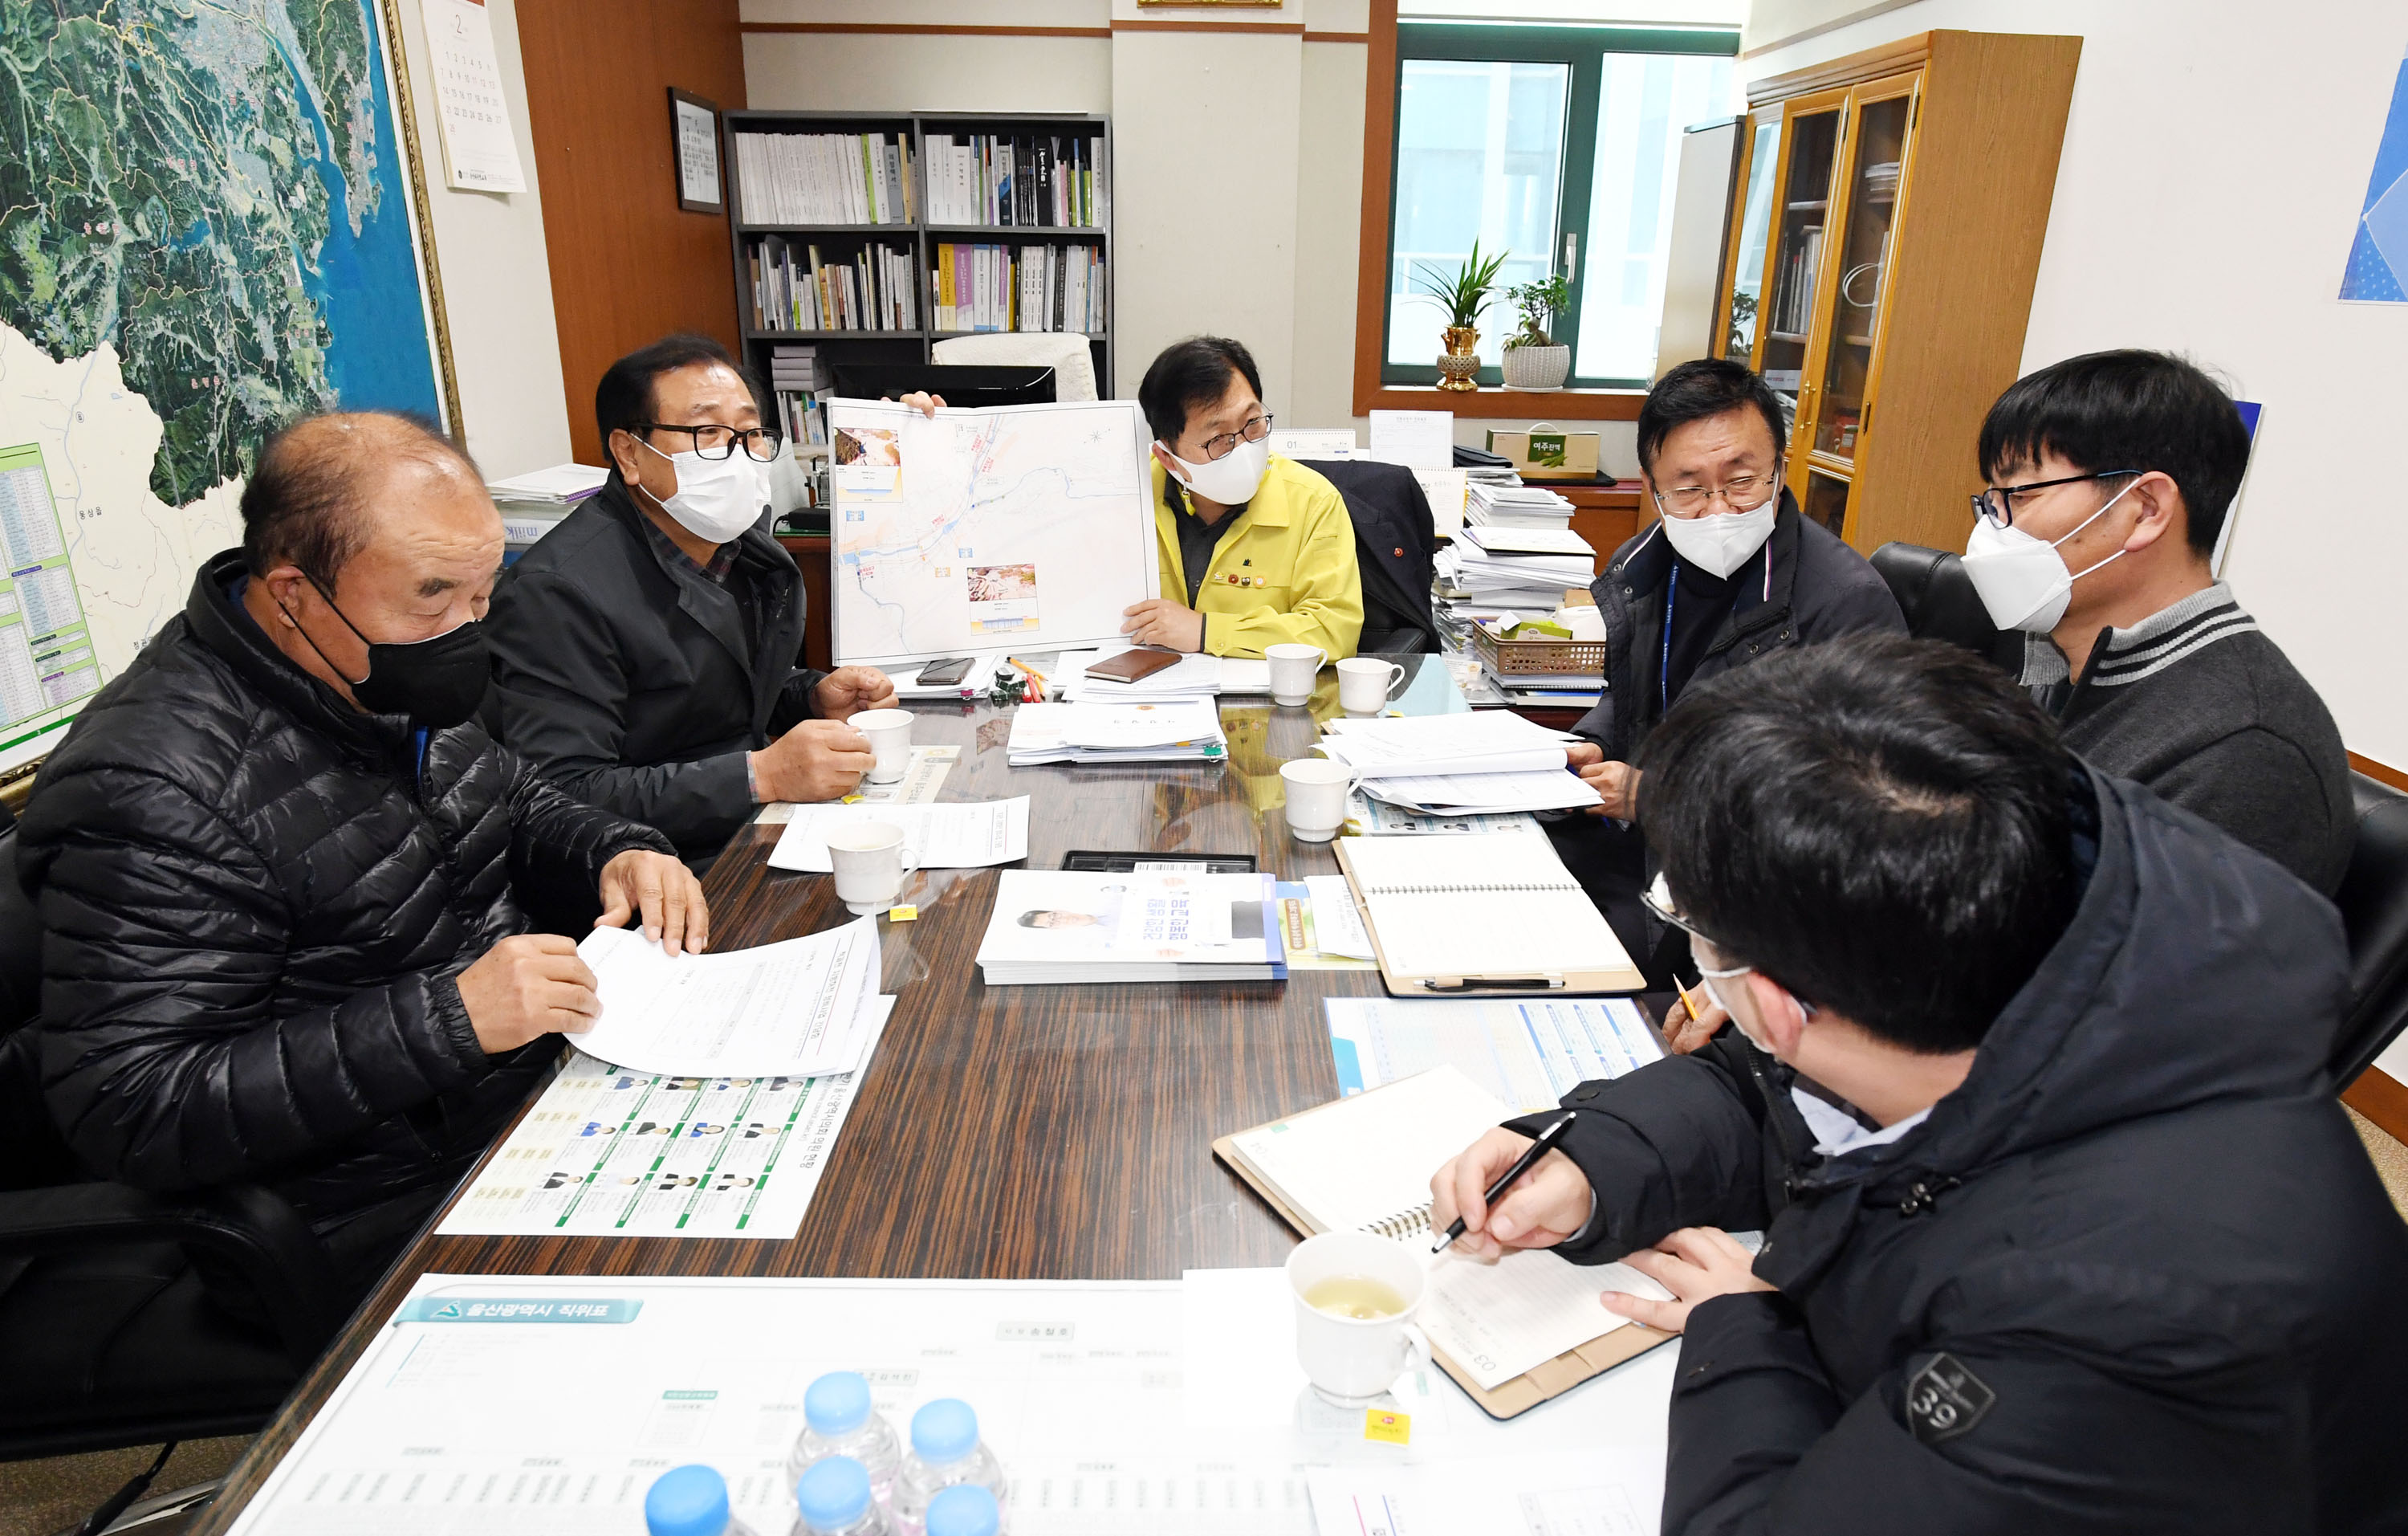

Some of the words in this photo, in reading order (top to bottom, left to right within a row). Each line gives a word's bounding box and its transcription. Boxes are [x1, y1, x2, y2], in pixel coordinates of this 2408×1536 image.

[455, 14, 462, 34] 2
[1287, 441, 1297, 449] 01
[1533, 442, 1561, 451] 여주진액
[807, 1136, 826, 1152] 의원
[466, 1302, 554, 1318] 울산광역시
[558, 1303, 611, 1318] 직위표
[1473, 1355, 1497, 1371] 03
[1911, 1388, 1958, 1430] 39
